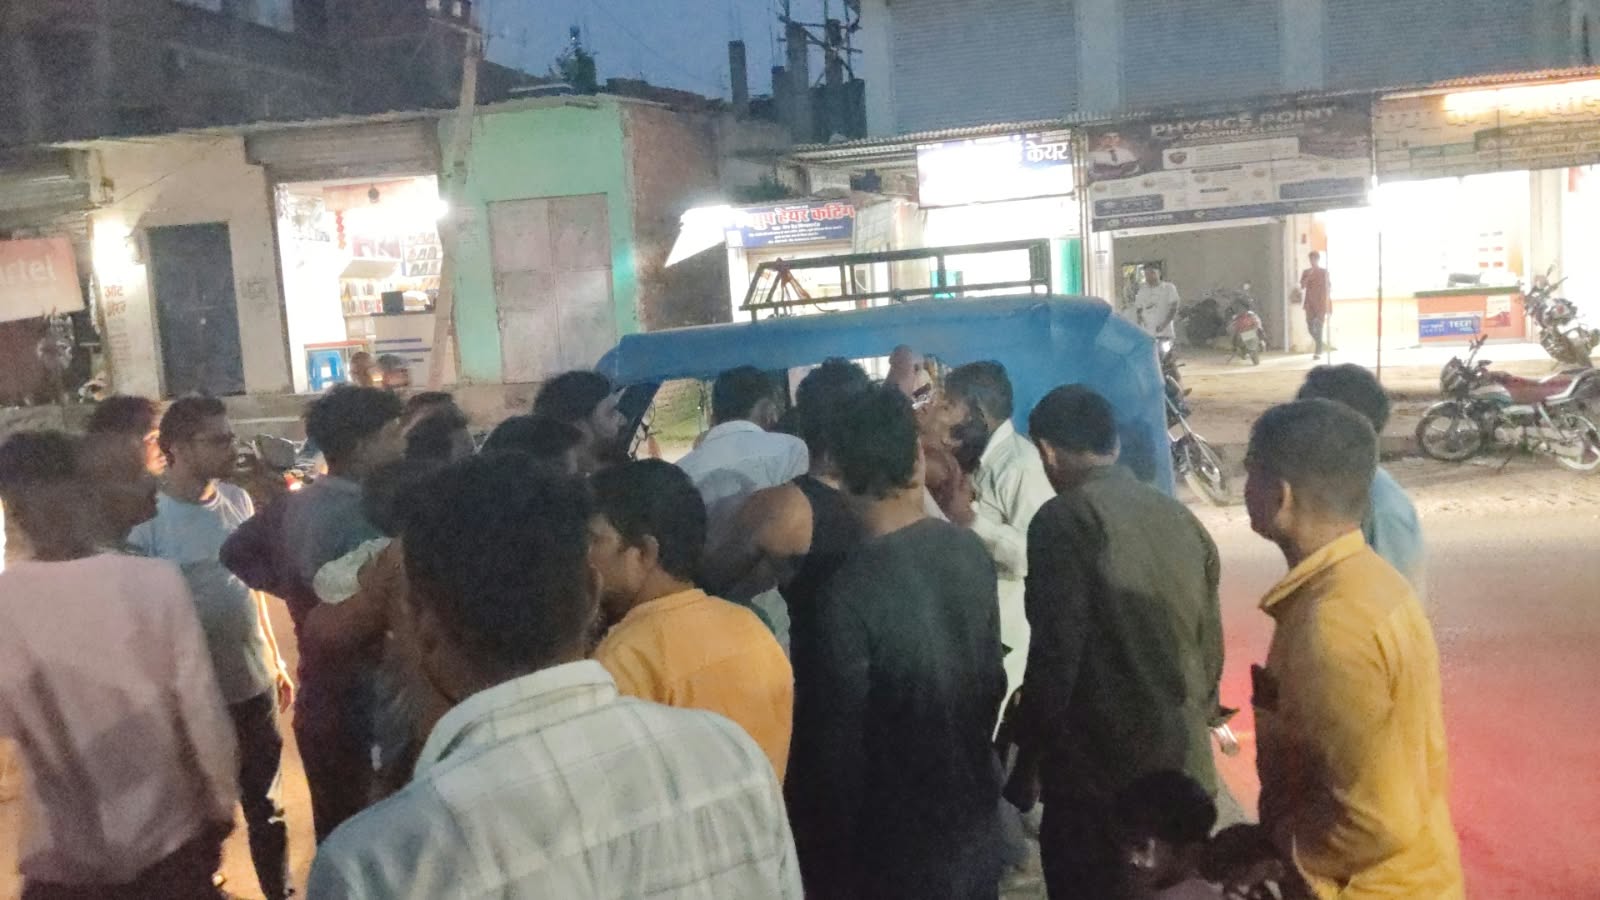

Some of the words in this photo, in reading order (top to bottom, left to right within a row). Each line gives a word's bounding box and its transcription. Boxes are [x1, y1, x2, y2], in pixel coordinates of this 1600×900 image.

[1151, 112, 1253, 137] PHYSICS
[1258, 105, 1338, 127] POINT
[1027, 141, 1069, 163] केयर
